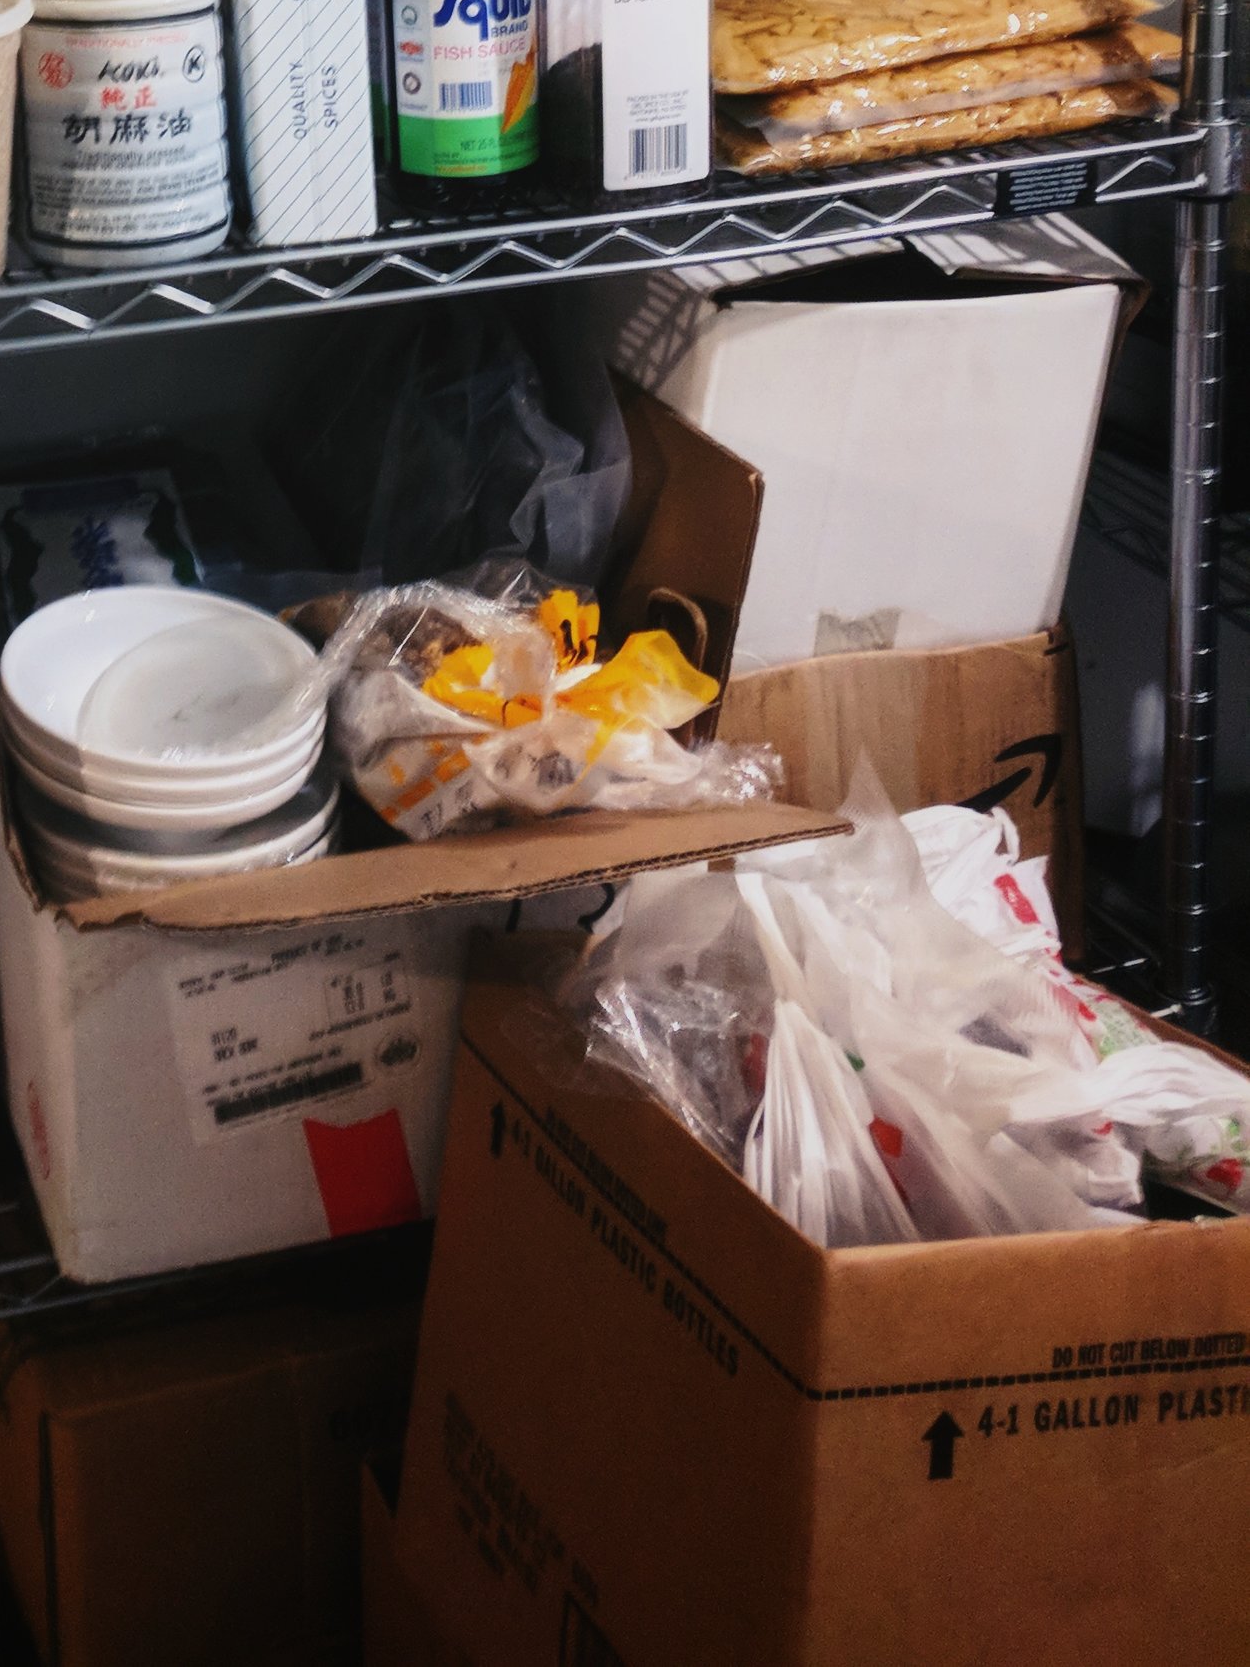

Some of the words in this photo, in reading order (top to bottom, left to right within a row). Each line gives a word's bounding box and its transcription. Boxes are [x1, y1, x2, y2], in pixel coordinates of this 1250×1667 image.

[433, 45, 473, 61] FISH
[477, 37, 527, 60] SAUCE
[490, 20, 529, 38] BRAND
[289, 62, 308, 141] QUALITY
[321, 66, 340, 129] SPICES
[62, 108, 193, 144] 胡麻油
[535, 1145, 588, 1219] GALLON
[590, 1207, 657, 1294] PLASTIC
[663, 1278, 739, 1377] BOTTLES
[1053, 1346, 1073, 1369] DO
[1078, 1343, 1106, 1365] NOT
[1110, 1340, 1137, 1364] CUT
[1141, 1336, 1190, 1361] BELOW
[1195, 1332, 1245, 1356] DOTTED
[978, 1403, 1020, 1437] 4-1
[1034, 1393, 1139, 1433] GALLON
